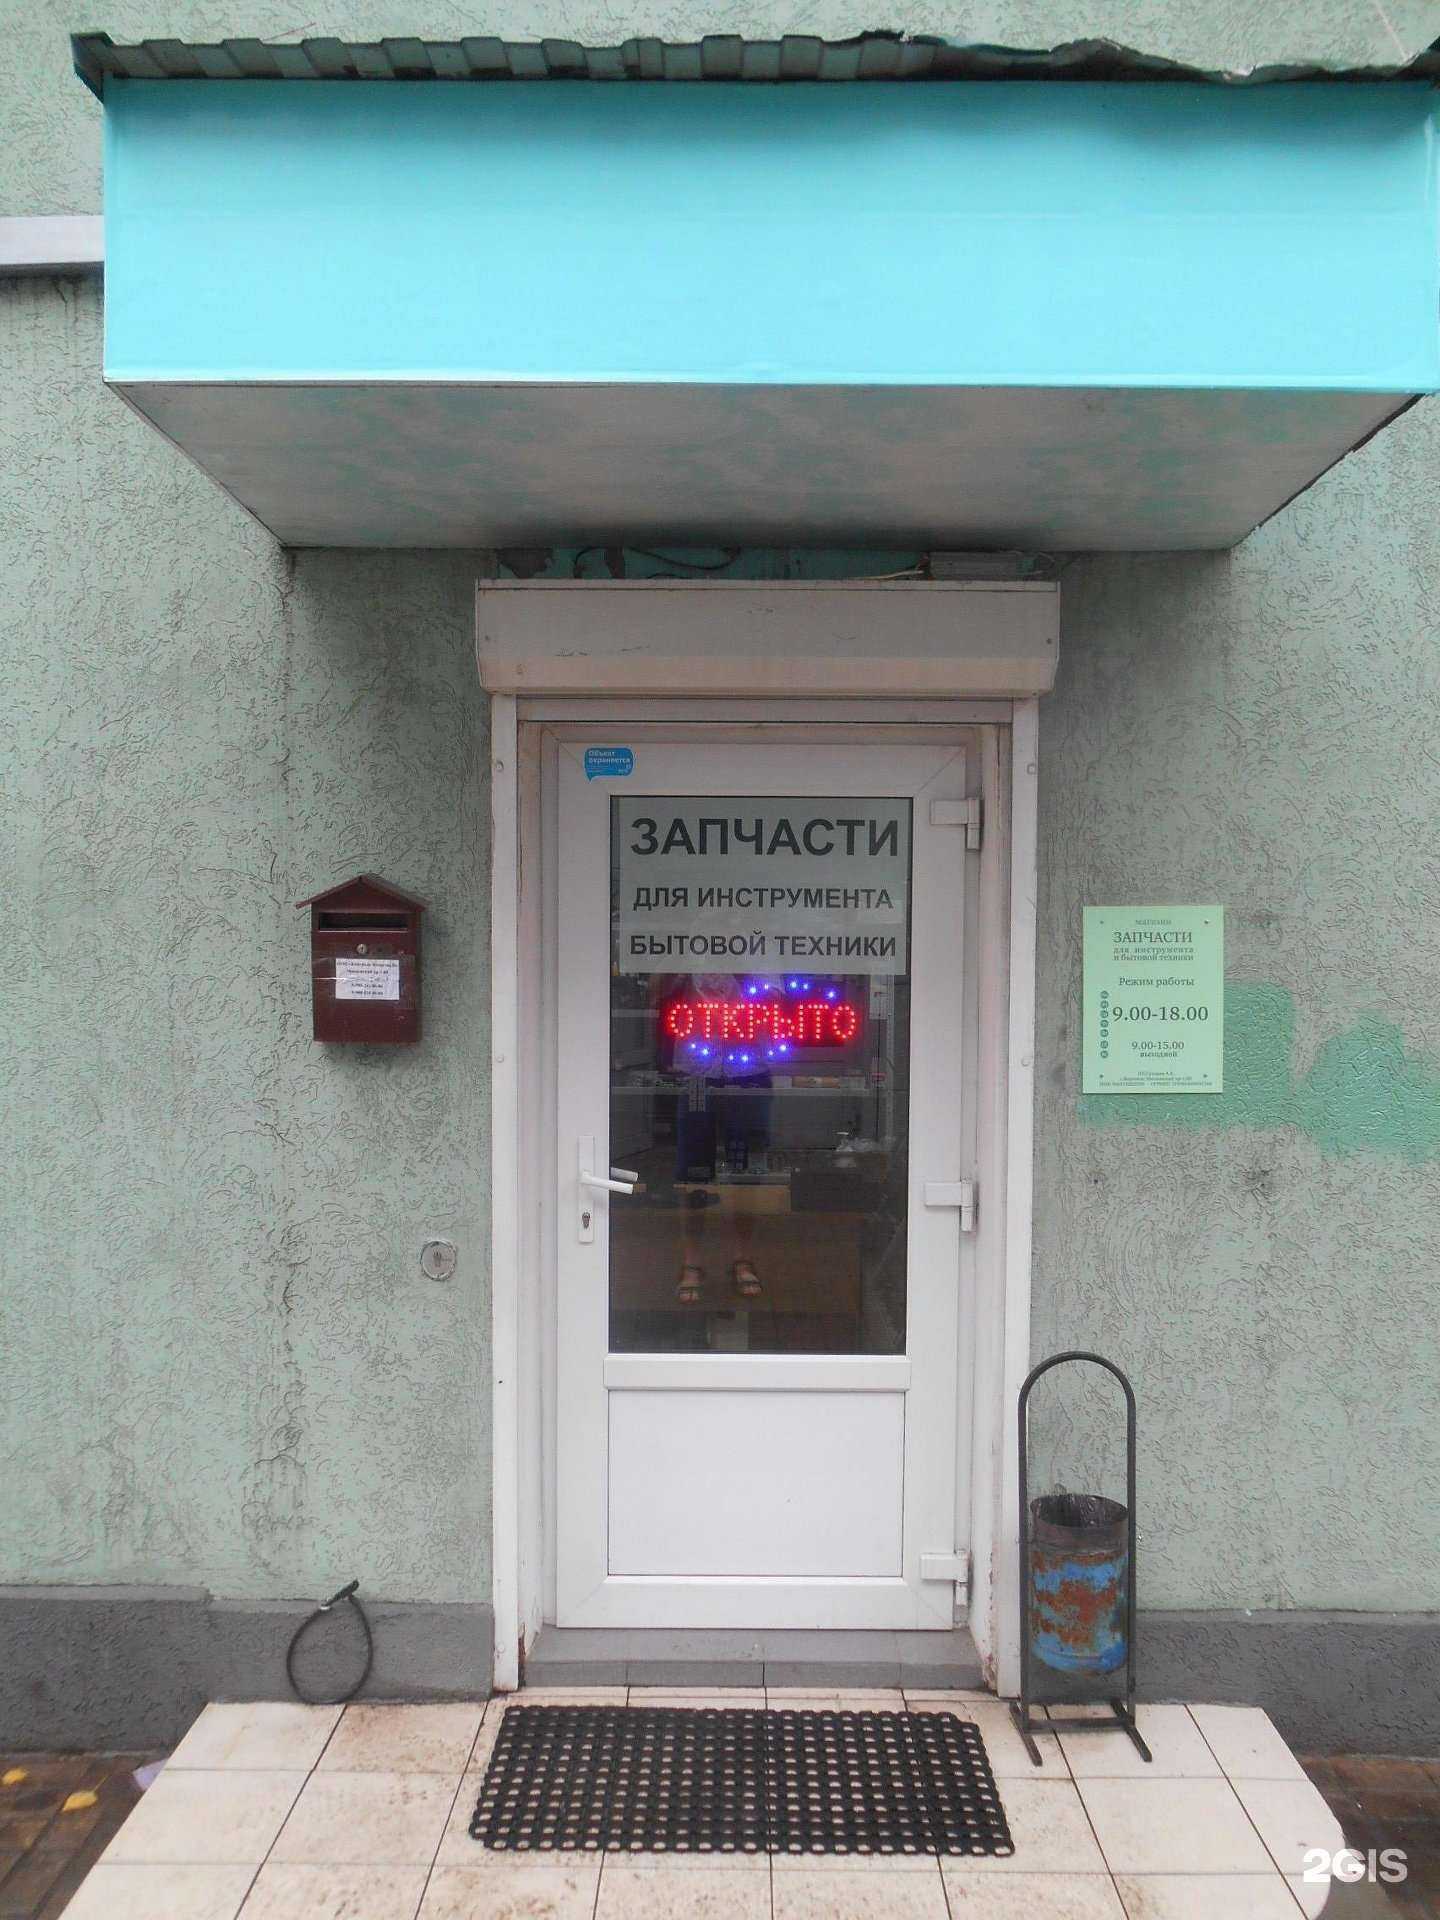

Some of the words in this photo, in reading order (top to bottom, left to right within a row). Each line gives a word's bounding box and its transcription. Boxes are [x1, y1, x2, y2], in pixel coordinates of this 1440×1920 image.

[630, 817, 898, 857] ЗАПЧАСТИ
[633, 887, 689, 911] ДЛЯ
[698, 887, 894, 909] ИНСТРУМЕНТА
[630, 930, 766, 956] БЫТОВОЙ
[775, 935, 896, 957] ТЕХНИКИ
[1113, 931, 1193, 944] ЗАПЧАСТИ
[1135, 947, 1194, 955] инструмента
[1118, 977, 1153, 986] Режим
[1156, 976, 1195, 988] работы
[669, 1003, 857, 1039] ОТКРЫТО
[1112, 1006, 1209, 1022] 9.00-18.00
[1131, 1041, 1185, 1050] 9.00-15.00
